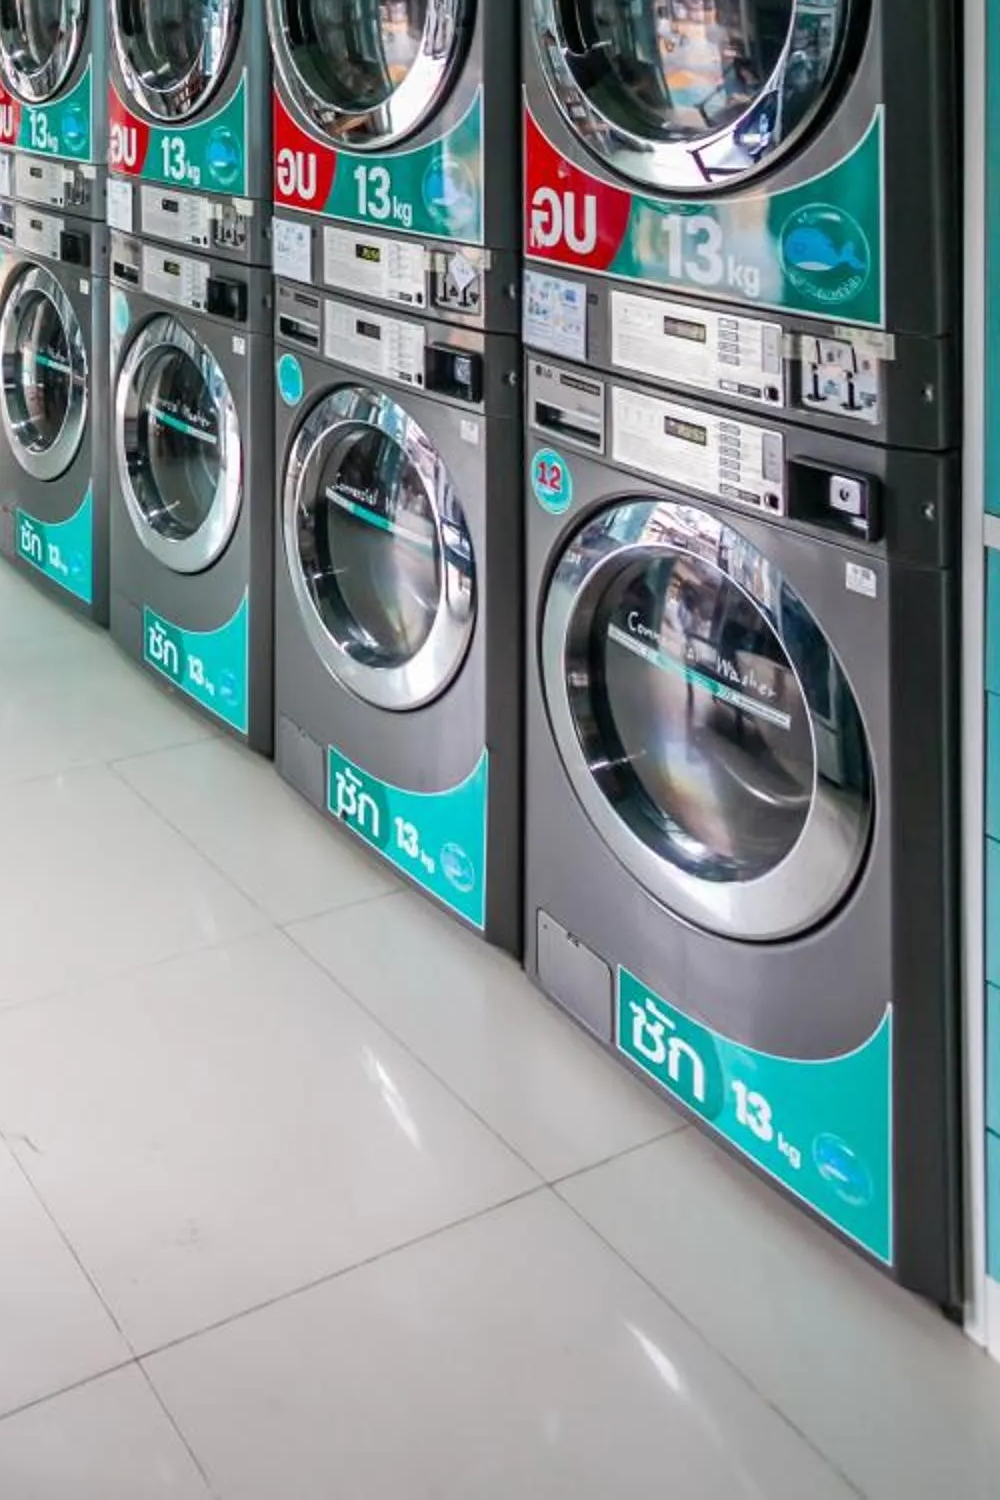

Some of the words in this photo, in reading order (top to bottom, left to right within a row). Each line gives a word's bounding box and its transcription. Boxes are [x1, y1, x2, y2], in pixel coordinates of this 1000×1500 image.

[30, 109, 48, 148] 13
[161, 135, 186, 180] 13
[187, 160, 201, 186] kg
[354, 165, 391, 220] 13
[393, 196, 413, 228] kg
[661, 213, 723, 287] 13
[728, 253, 761, 298] kg
[536, 461, 562, 493] 12
[187, 653, 205, 686] 13
[717, 654, 777, 699] Washer
[395, 816, 419, 859] 13
[731, 1079, 773, 1143] 13
[777, 1131, 801, 1170] kg
